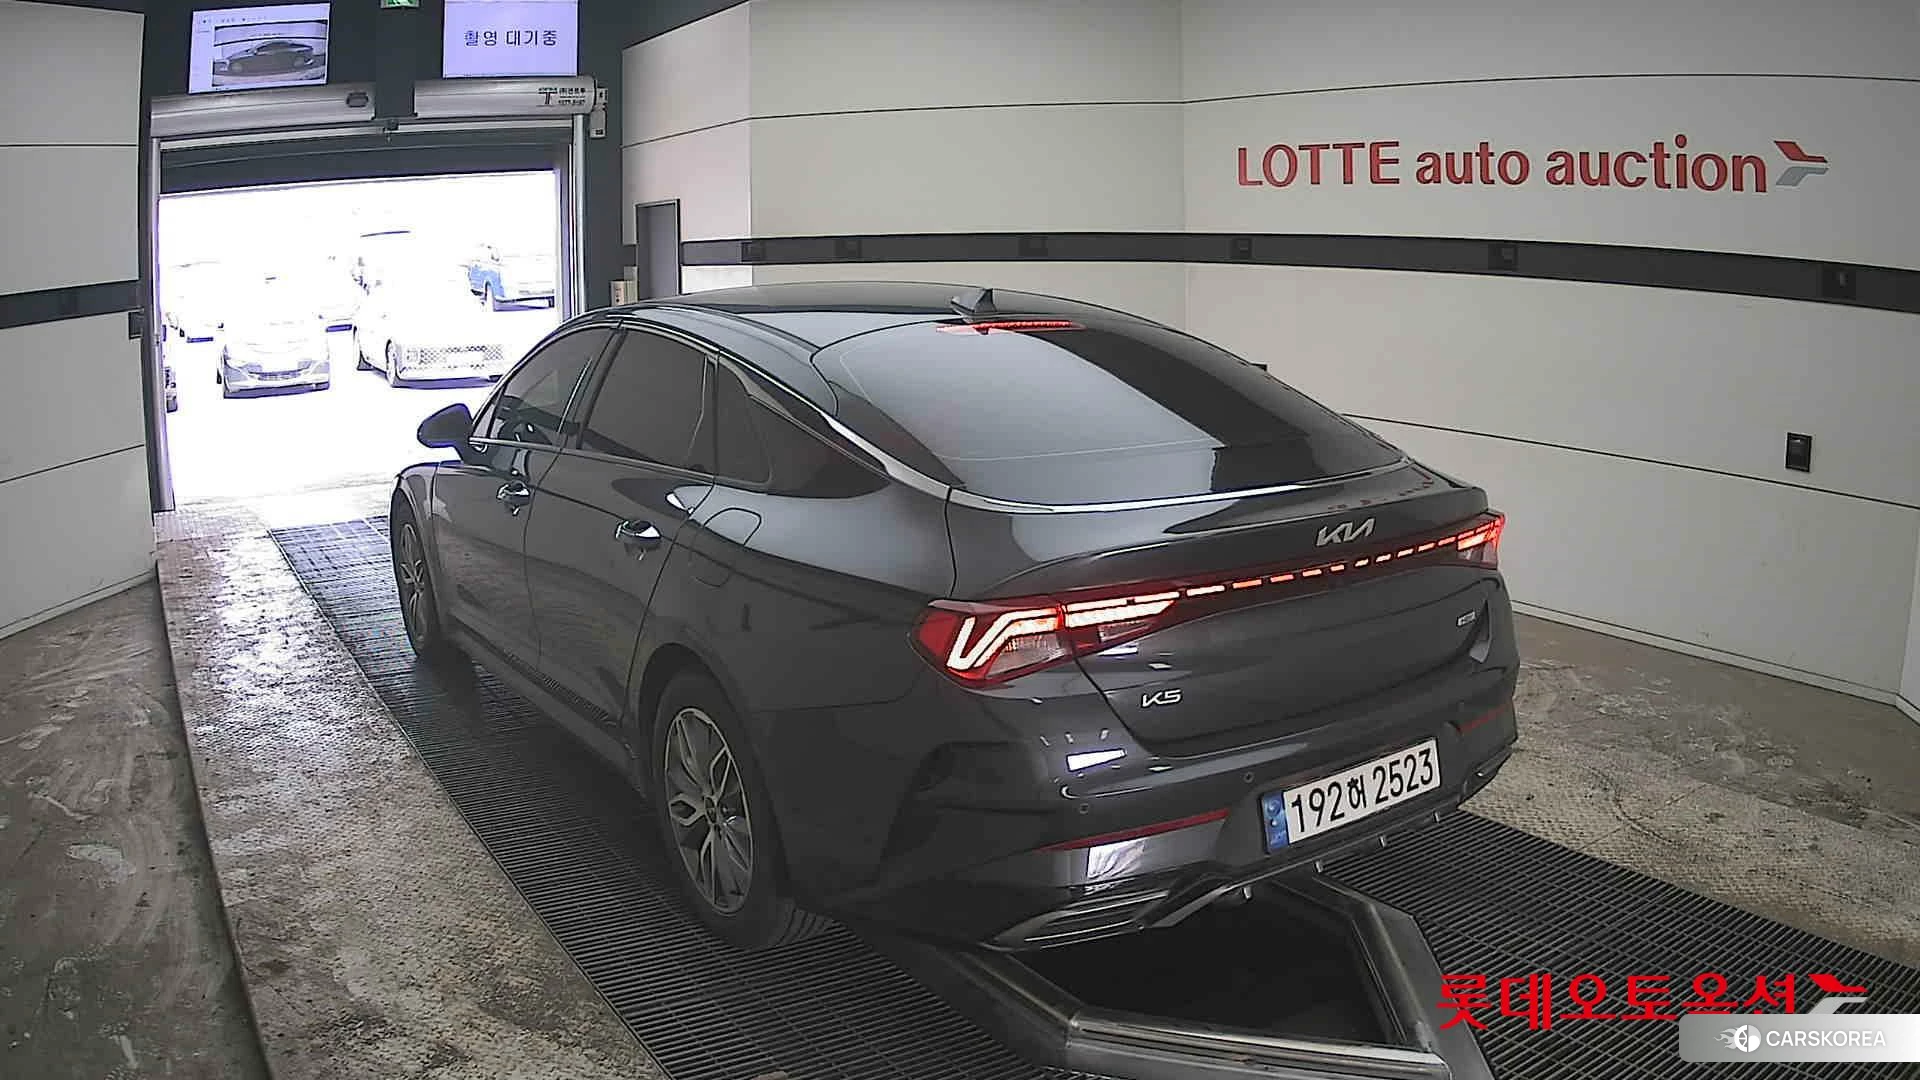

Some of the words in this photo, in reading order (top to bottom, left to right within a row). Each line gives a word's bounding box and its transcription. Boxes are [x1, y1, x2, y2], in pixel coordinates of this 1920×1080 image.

[506, 30, 557, 46] 대기중
[1236, 140, 1400, 187] LOTTE
[1415, 142, 1530, 186] auto
[1545, 134, 1767, 194] auction
[1142, 689, 1181, 707] K5
[1291, 774, 1367, 833] 192허
[1372, 748, 1434, 805] 2523
